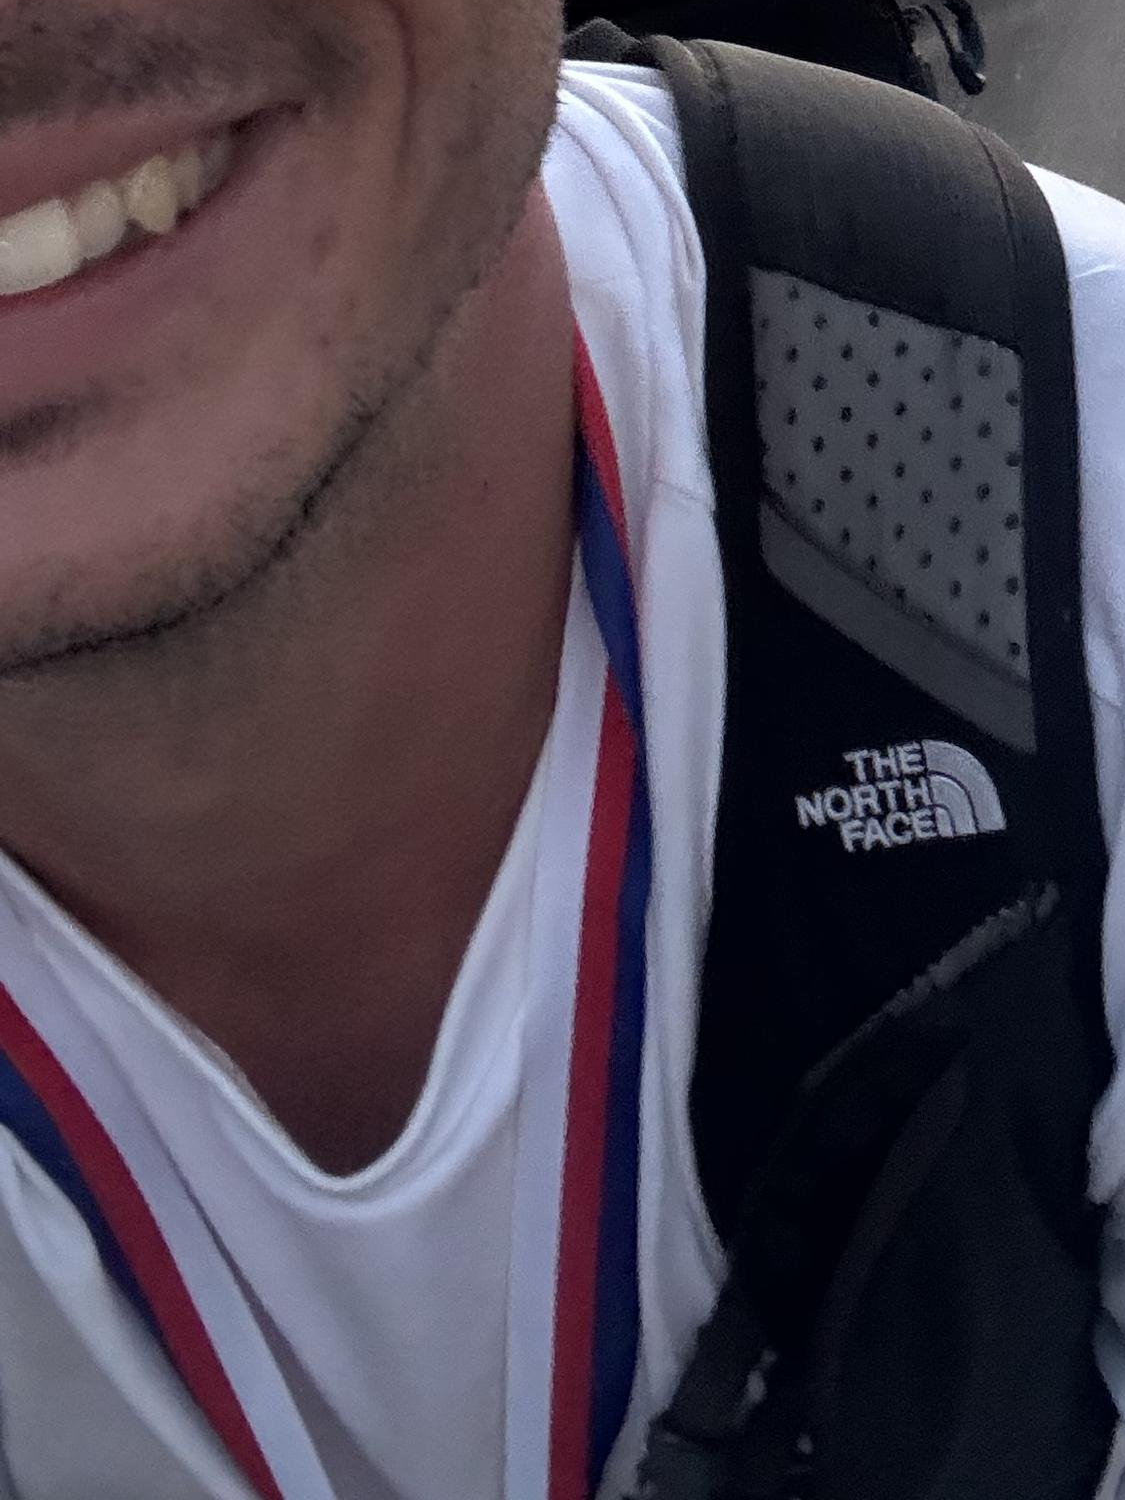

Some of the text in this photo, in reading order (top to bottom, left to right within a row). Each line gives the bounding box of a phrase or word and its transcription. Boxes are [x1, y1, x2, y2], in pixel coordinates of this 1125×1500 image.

[843, 741, 925, 782] THE
[795, 776, 932, 829] NORTH
[840, 808, 938, 852] FACE
